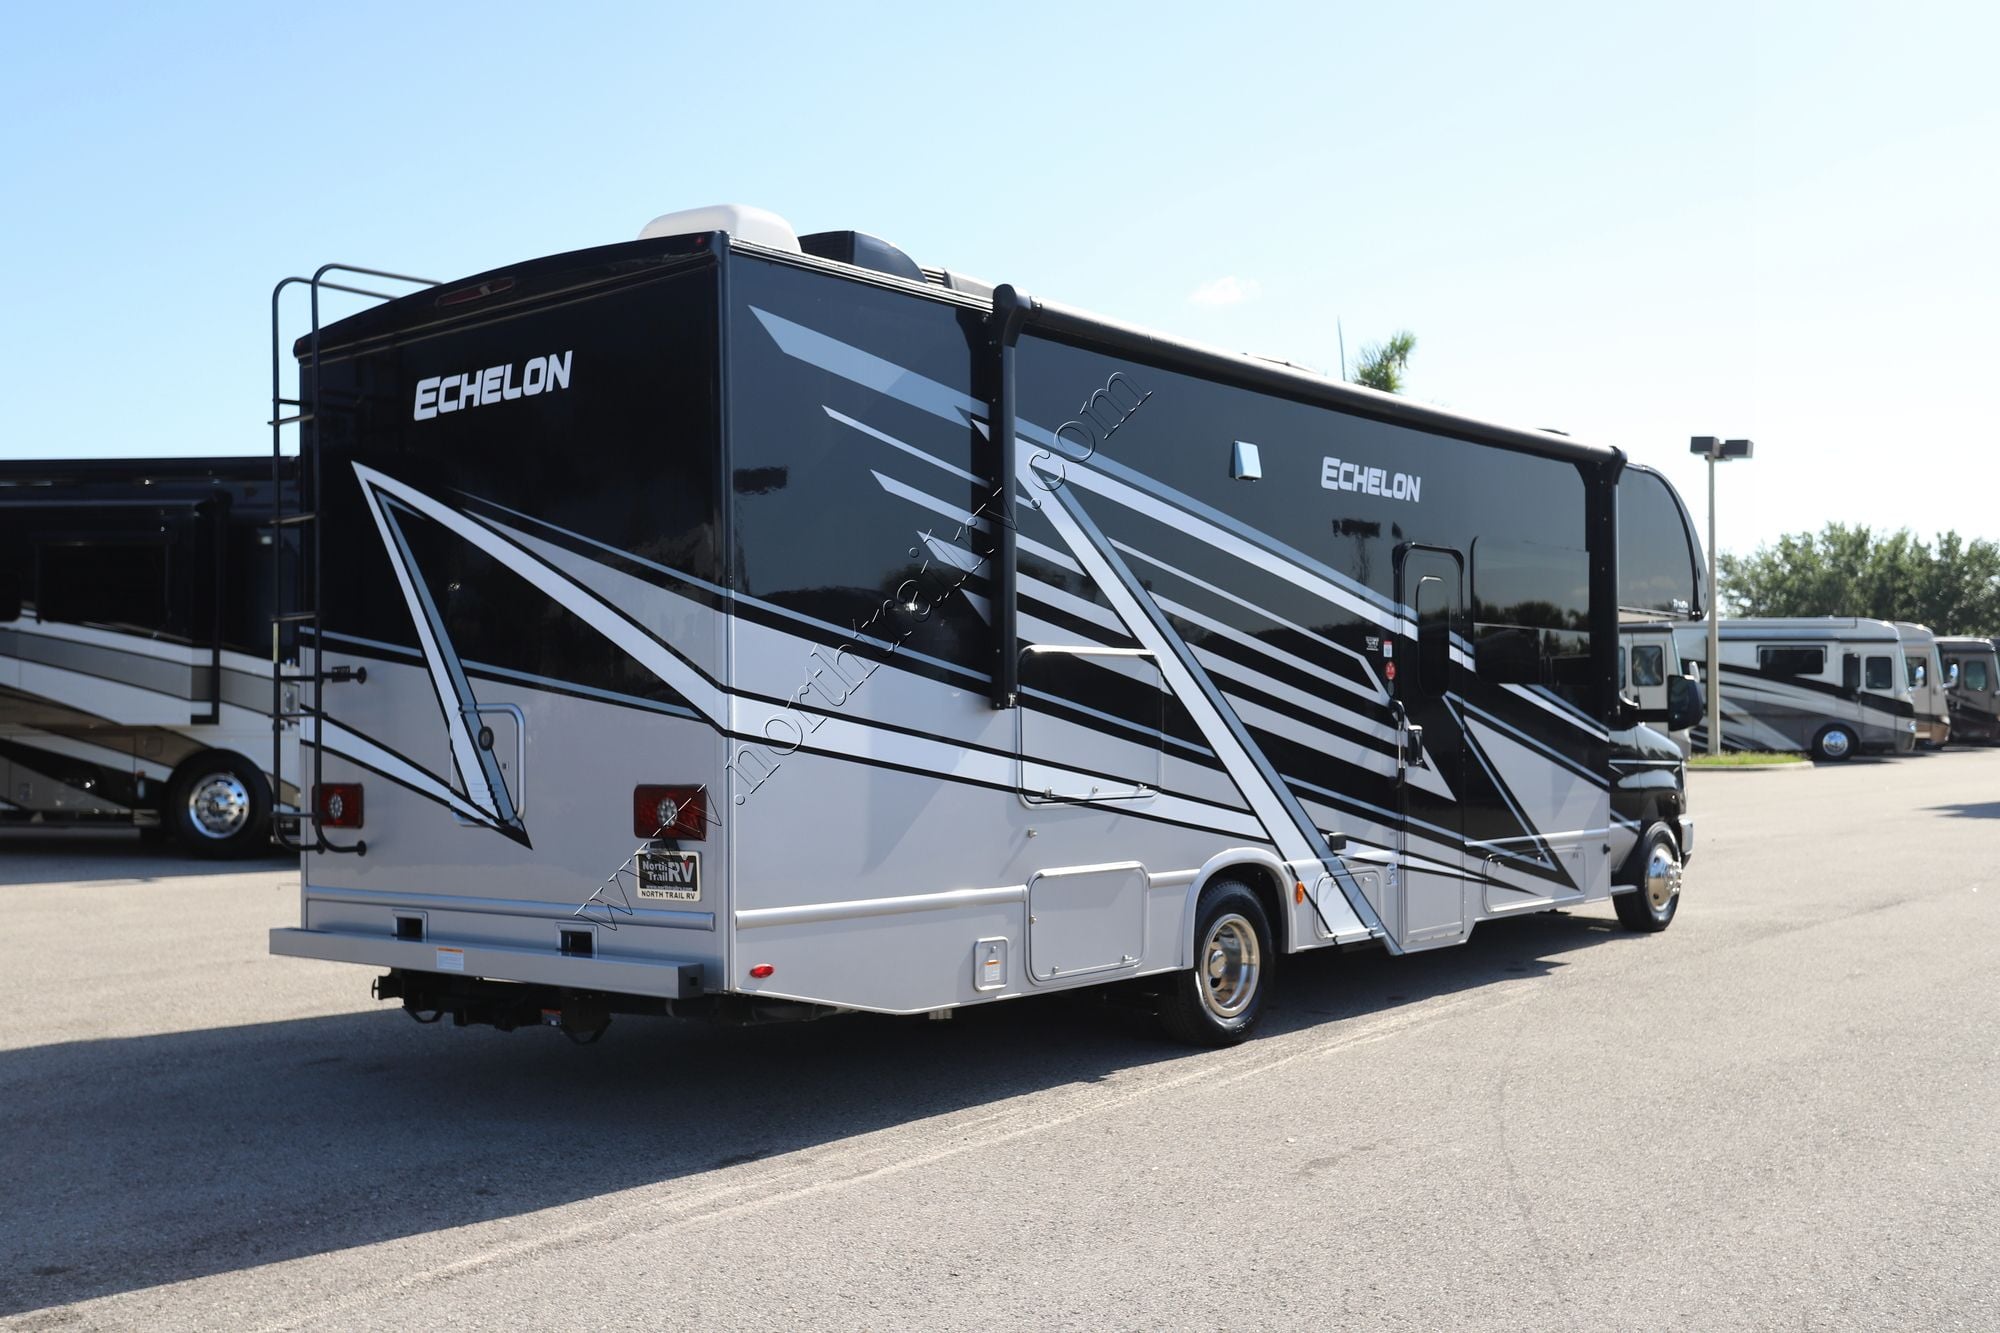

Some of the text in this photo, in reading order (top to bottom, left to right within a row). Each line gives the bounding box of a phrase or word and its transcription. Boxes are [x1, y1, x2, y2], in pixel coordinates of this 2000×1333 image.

[414, 350, 573, 421] ECHELON
[1321, 456, 1421, 502] ECHELON
[642, 861, 668, 871] North
[668, 862, 694, 882] RV
[648, 872, 668, 881] Trail
[641, 890, 663, 898] NORTH
[665, 891, 684, 899] TRAIL
